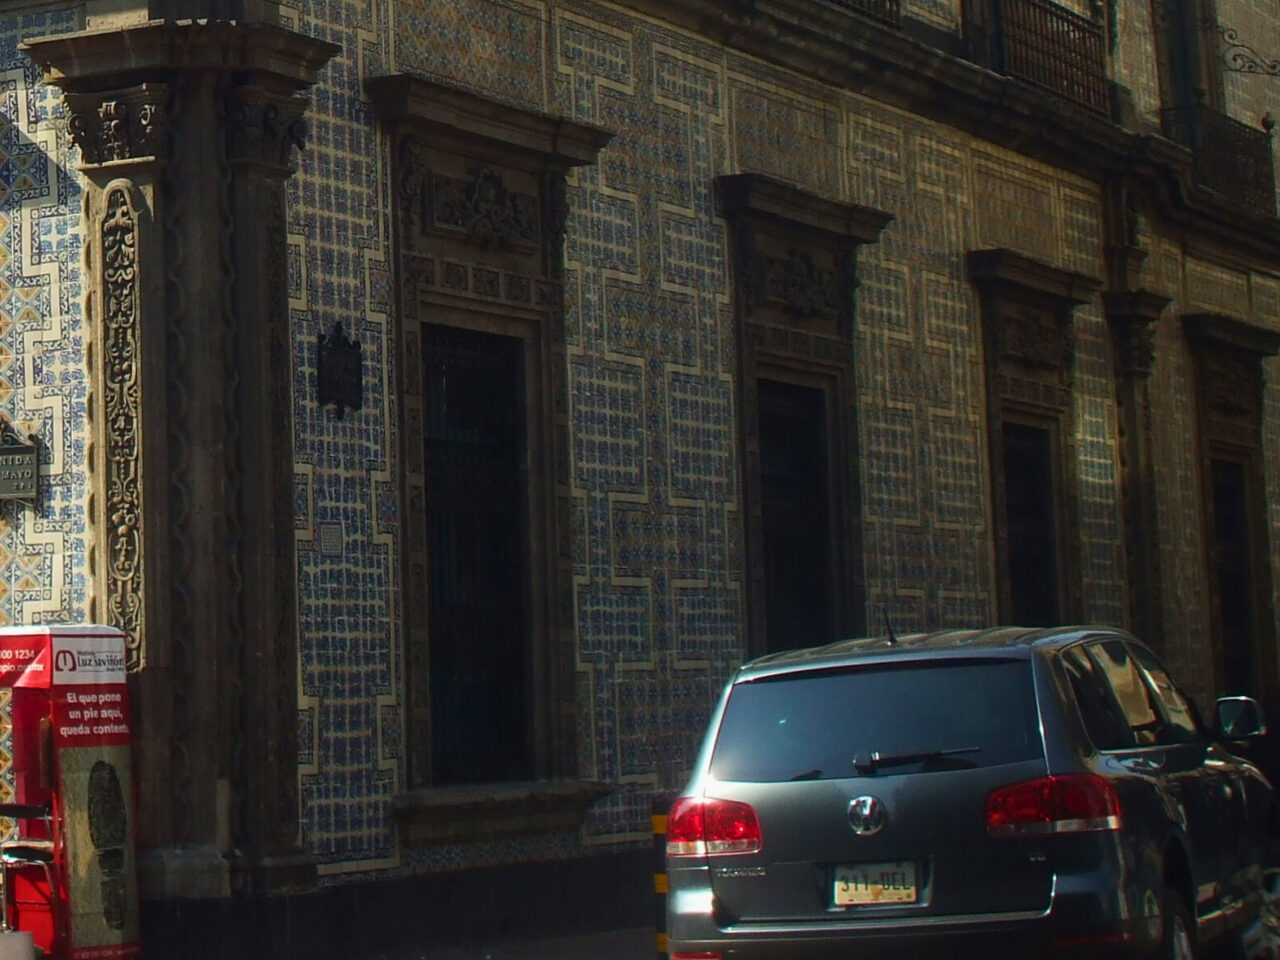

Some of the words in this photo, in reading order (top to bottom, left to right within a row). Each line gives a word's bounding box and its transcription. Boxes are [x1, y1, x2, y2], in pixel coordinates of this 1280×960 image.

[1, 469, 32, 480] MAYO
[15, 649, 35, 659] 1234
[77, 655, 92, 667] Luz
[67, 692, 77, 703] El
[79, 694, 97, 705] que
[98, 694, 121, 705] pone
[69, 710, 81, 719] un
[83, 707, 99, 721] pie
[60, 724, 90, 737] queda
